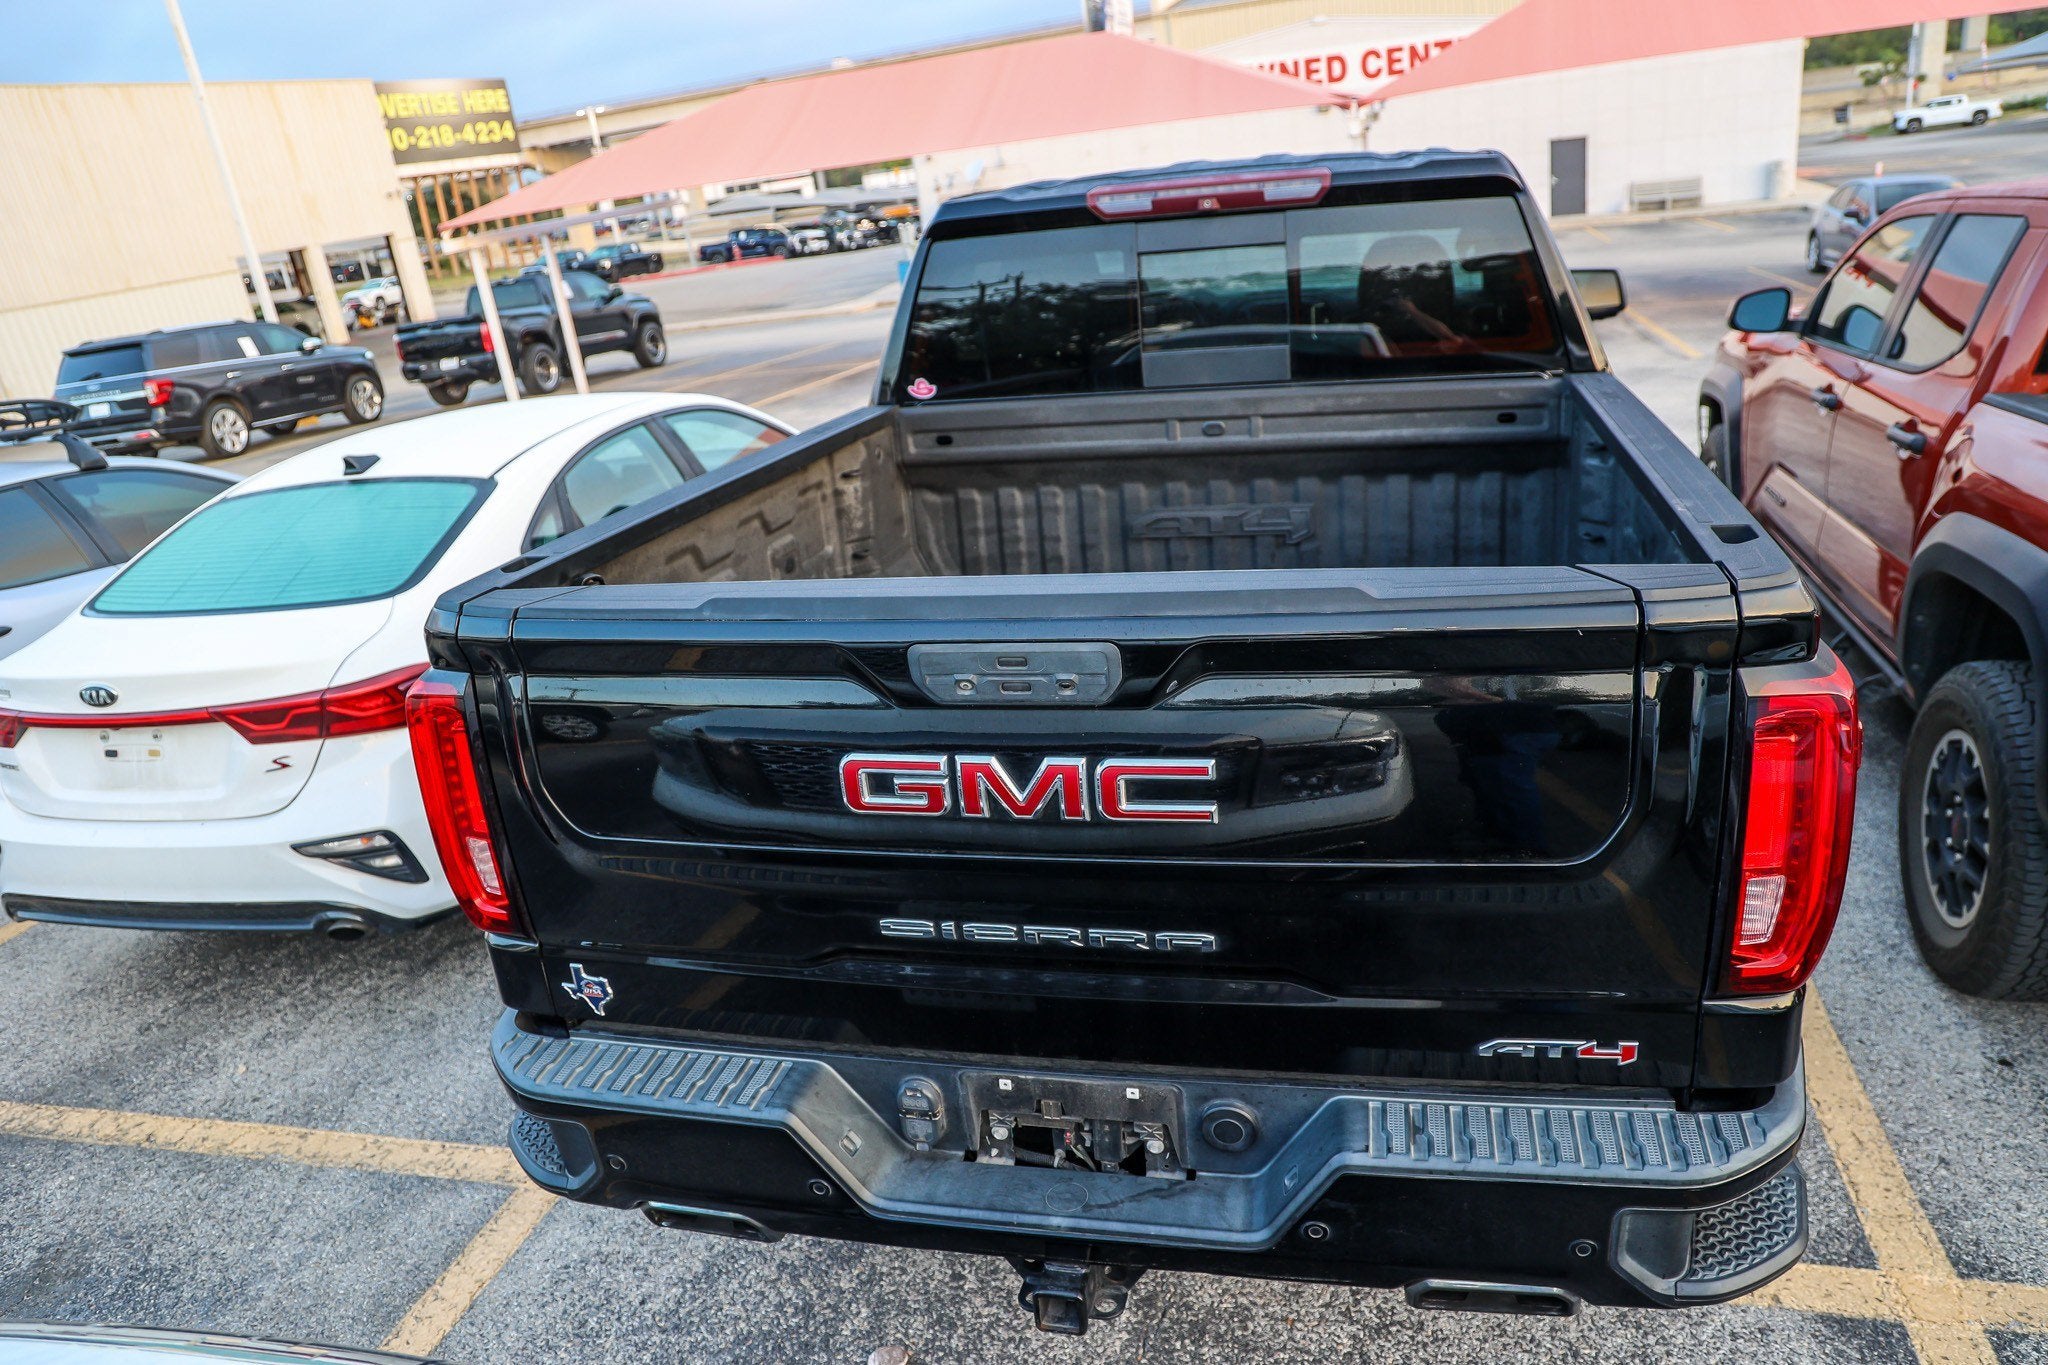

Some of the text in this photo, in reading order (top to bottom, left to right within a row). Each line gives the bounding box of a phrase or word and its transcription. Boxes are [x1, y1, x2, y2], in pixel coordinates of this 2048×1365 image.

[1258, 41, 1460, 84] NED CENT
[461, 88, 511, 114] HERE
[80, 686, 114, 706] KIA
[839, 753, 1220, 824] GMC
[879, 917, 1217, 953] SIERRA
[1479, 1038, 1640, 1066] AT4
